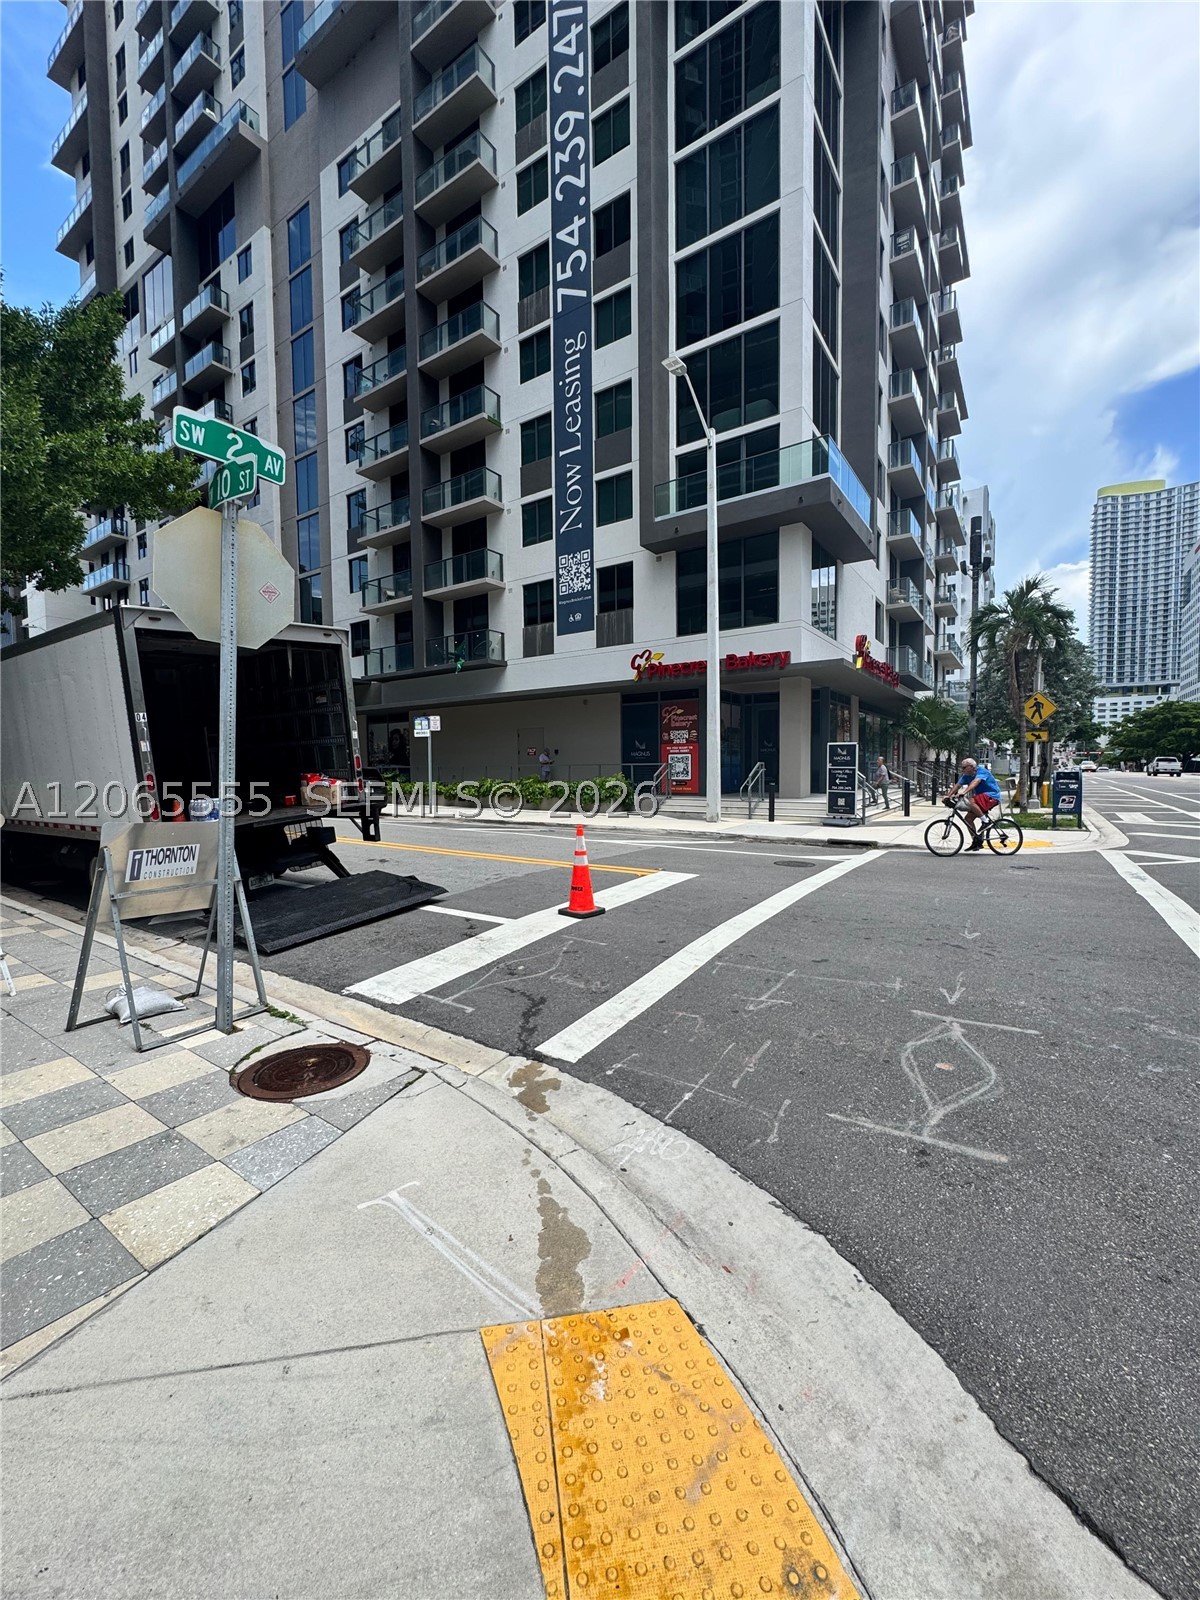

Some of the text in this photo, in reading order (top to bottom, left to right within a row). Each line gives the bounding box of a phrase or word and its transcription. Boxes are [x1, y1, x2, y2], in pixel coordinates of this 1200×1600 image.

[552, 0, 588, 535] Now Leasing 754.239.247
[179, 420, 281, 477] SW 2 AV
[217, 469, 231, 500] 10
[239, 469, 251, 491] ST
[647, 651, 791, 677] Pinecre Bakery
[145, 845, 197, 866] THORNTON
[143, 867, 195, 880] CONSTRUCTION
